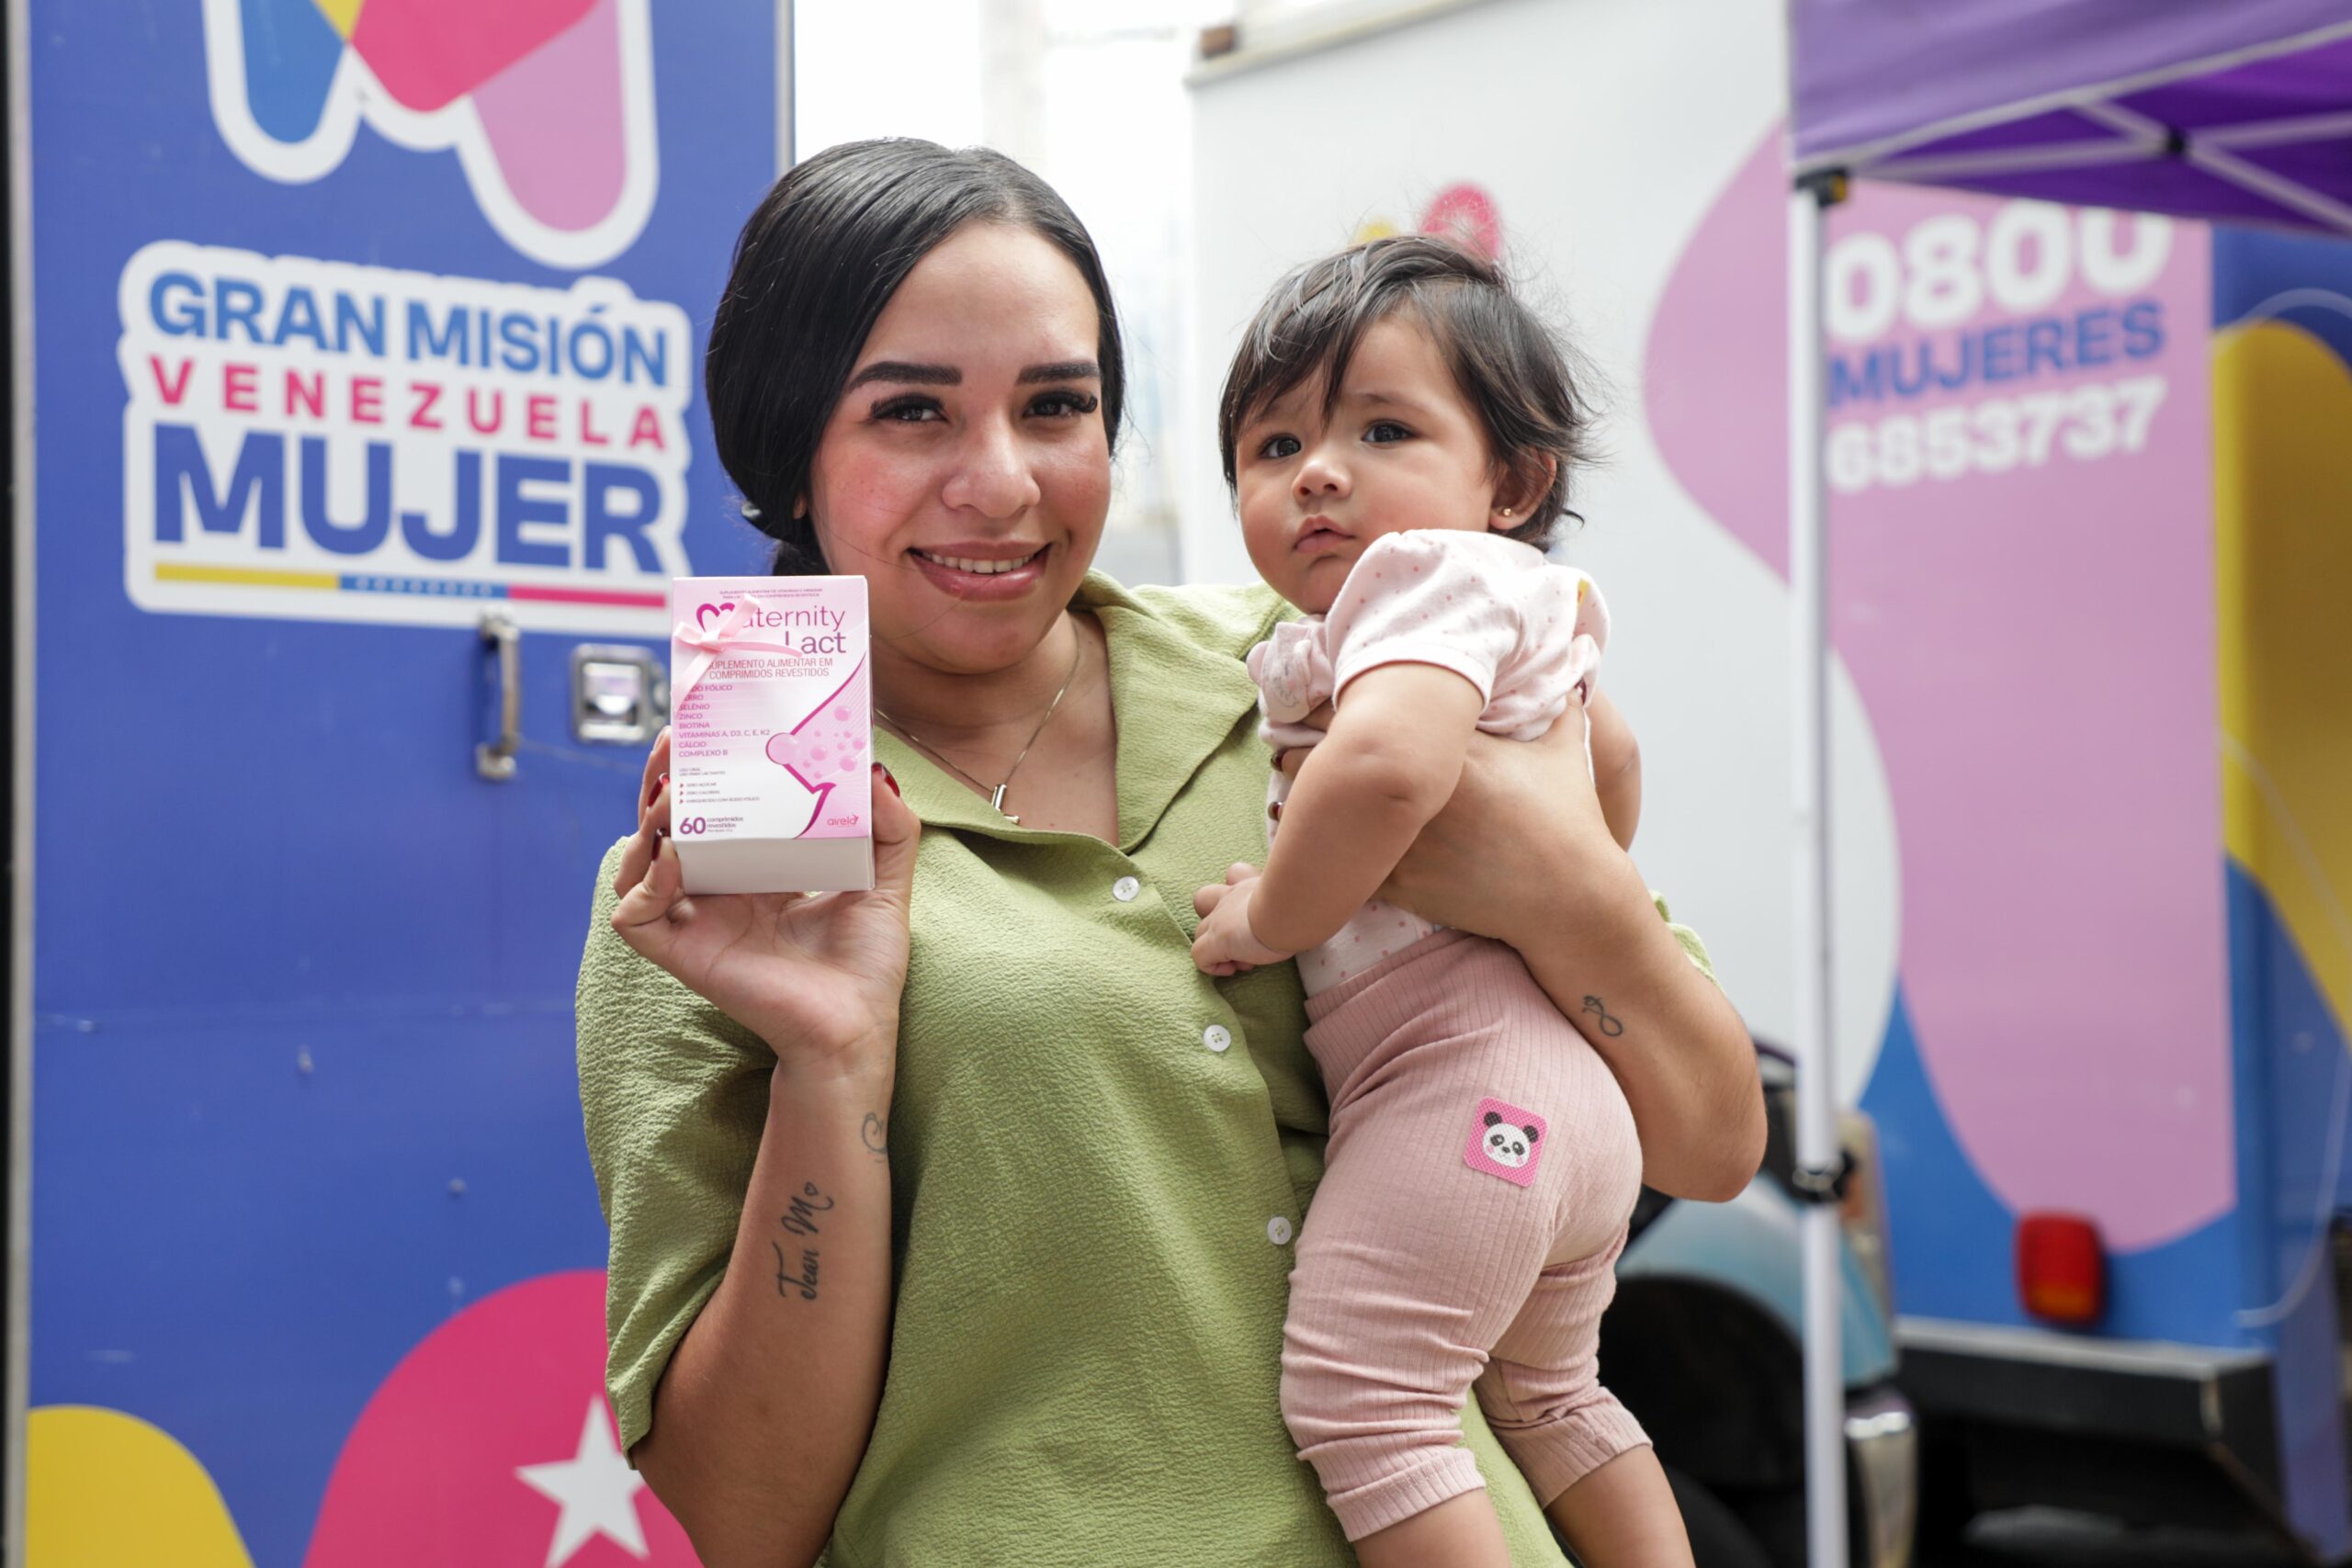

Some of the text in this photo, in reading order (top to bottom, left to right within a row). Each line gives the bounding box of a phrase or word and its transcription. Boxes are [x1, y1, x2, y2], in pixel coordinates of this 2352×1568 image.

[1824, 199, 2174, 343] 0800
[148, 270, 668, 389] GRAN MISIÓN
[1826, 300, 2166, 407] MUJERES
[149, 355, 667, 451] VENEZUELA
[1825, 374, 2168, 495] 6853737
[152, 423, 667, 575] MUJER
[709, 667, 830, 680] COMPRIMIDOS REVESTIDOS
[767, 658, 817, 667] ALIMENTAR
[819, 657, 832, 667] EM
[705, 683, 733, 692] FÓLICO
[678, 740, 707, 749] CÁLCIO
[678, 750, 721, 758] COMPLEXO
[679, 730, 720, 739] VITAMINAS
[679, 817, 707, 835] 60
[772, 1241, 820, 1301] Jean
